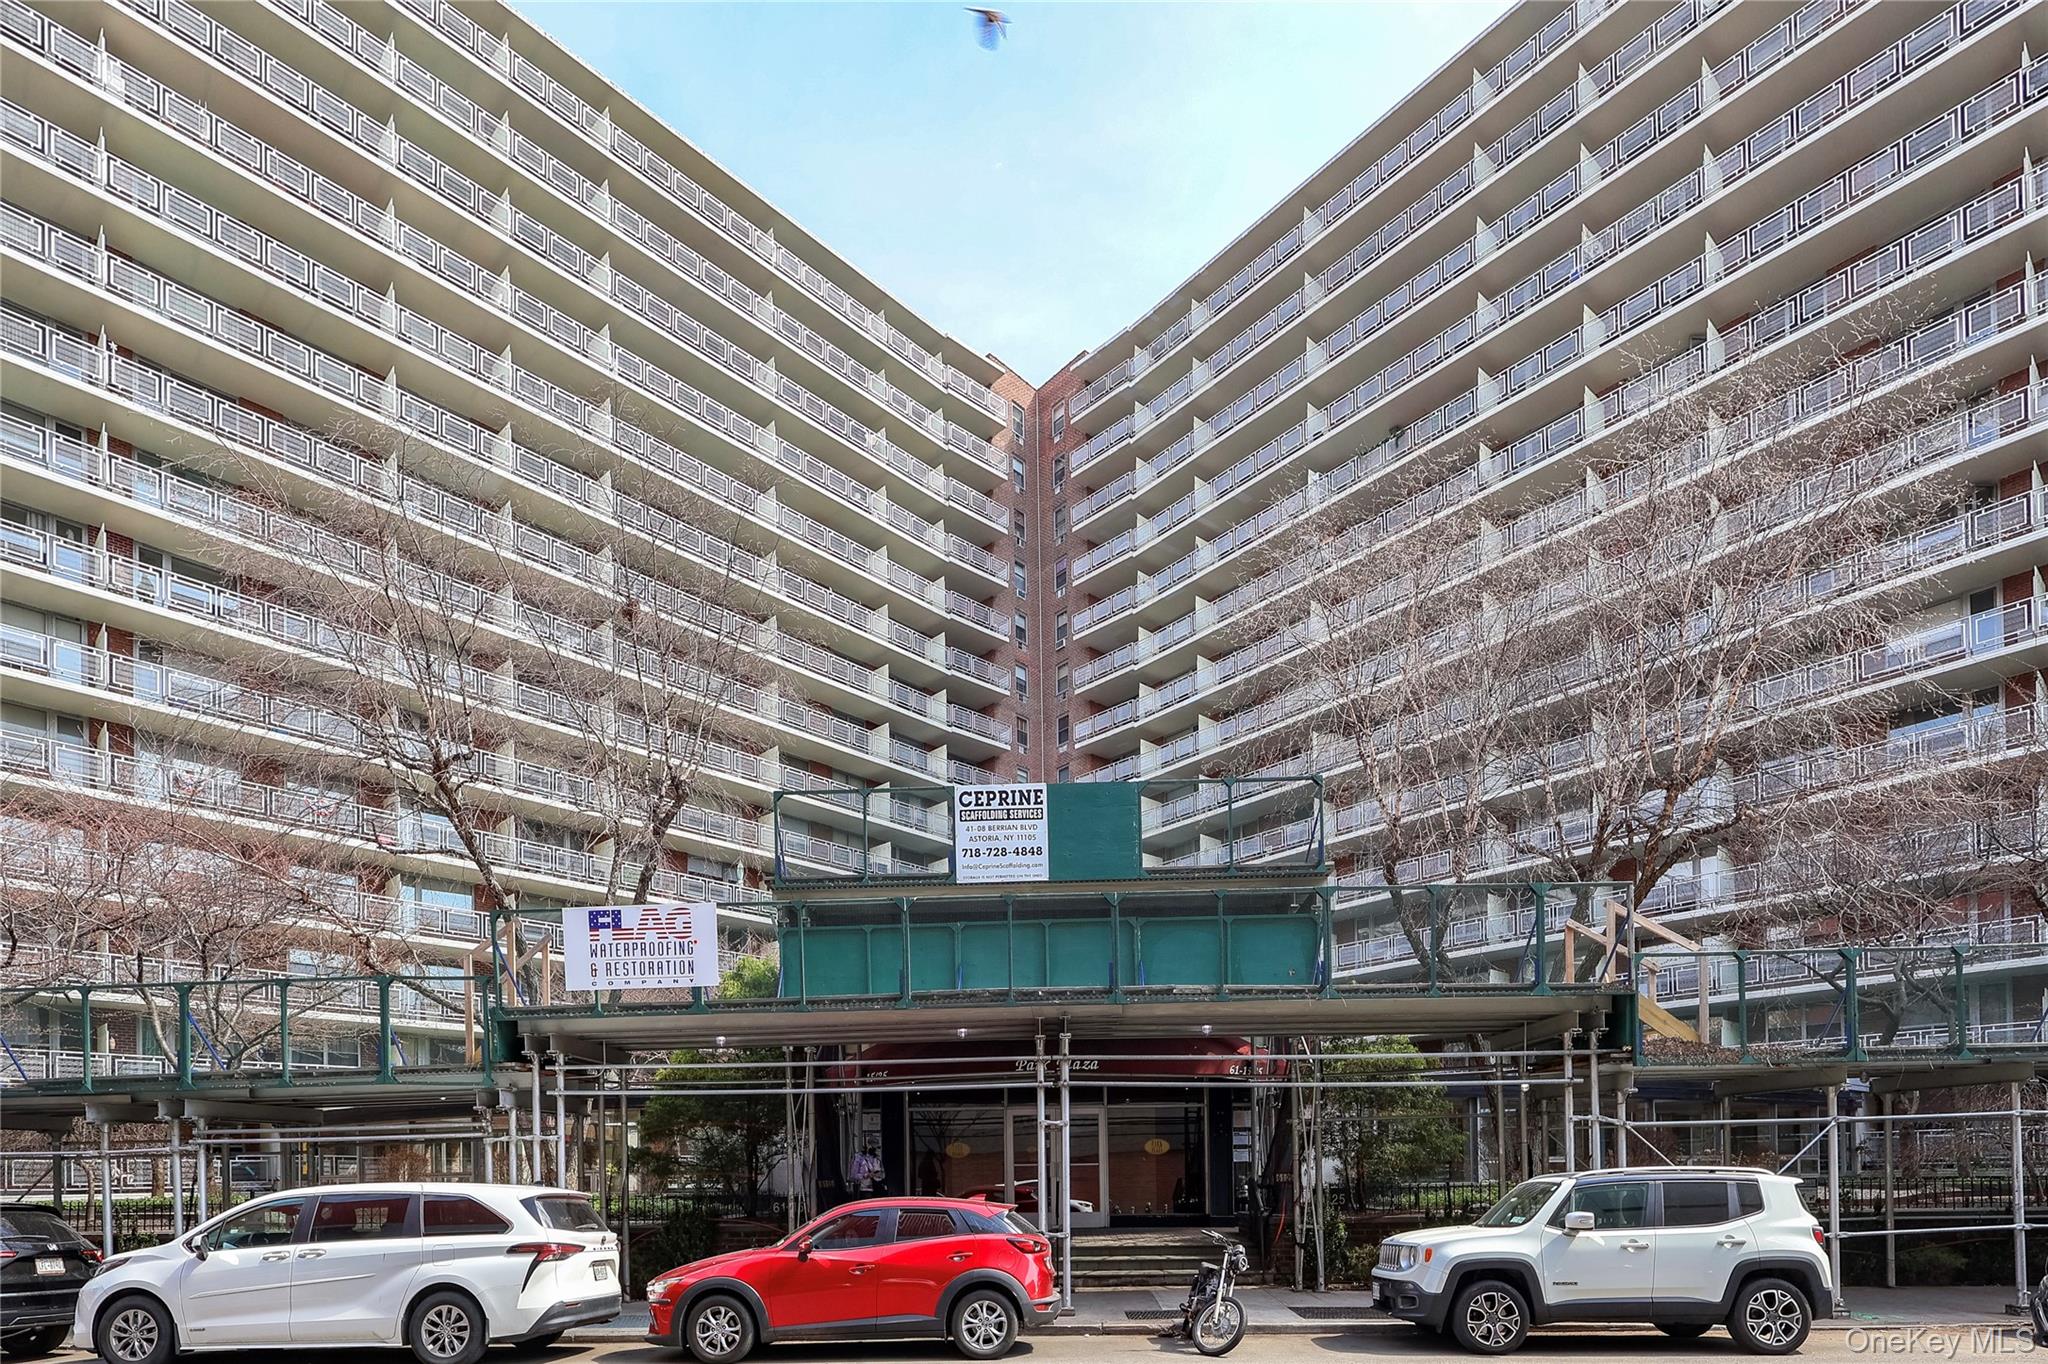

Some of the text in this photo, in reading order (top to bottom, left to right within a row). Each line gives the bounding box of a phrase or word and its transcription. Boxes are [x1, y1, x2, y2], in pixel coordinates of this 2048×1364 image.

[959, 789, 1043, 807] CEPRINE
[961, 808, 1043, 821] SCAFFOLDING SERVICES
[968, 835, 1002, 843] ASTORIA,
[961, 846, 1043, 858] 718-728-4848
[588, 907, 692, 942] FLAG
[589, 940, 694, 958] WATERPROOFING
[591, 959, 695, 977] & RESTORATION
[591, 978, 695, 987] COMPANY
